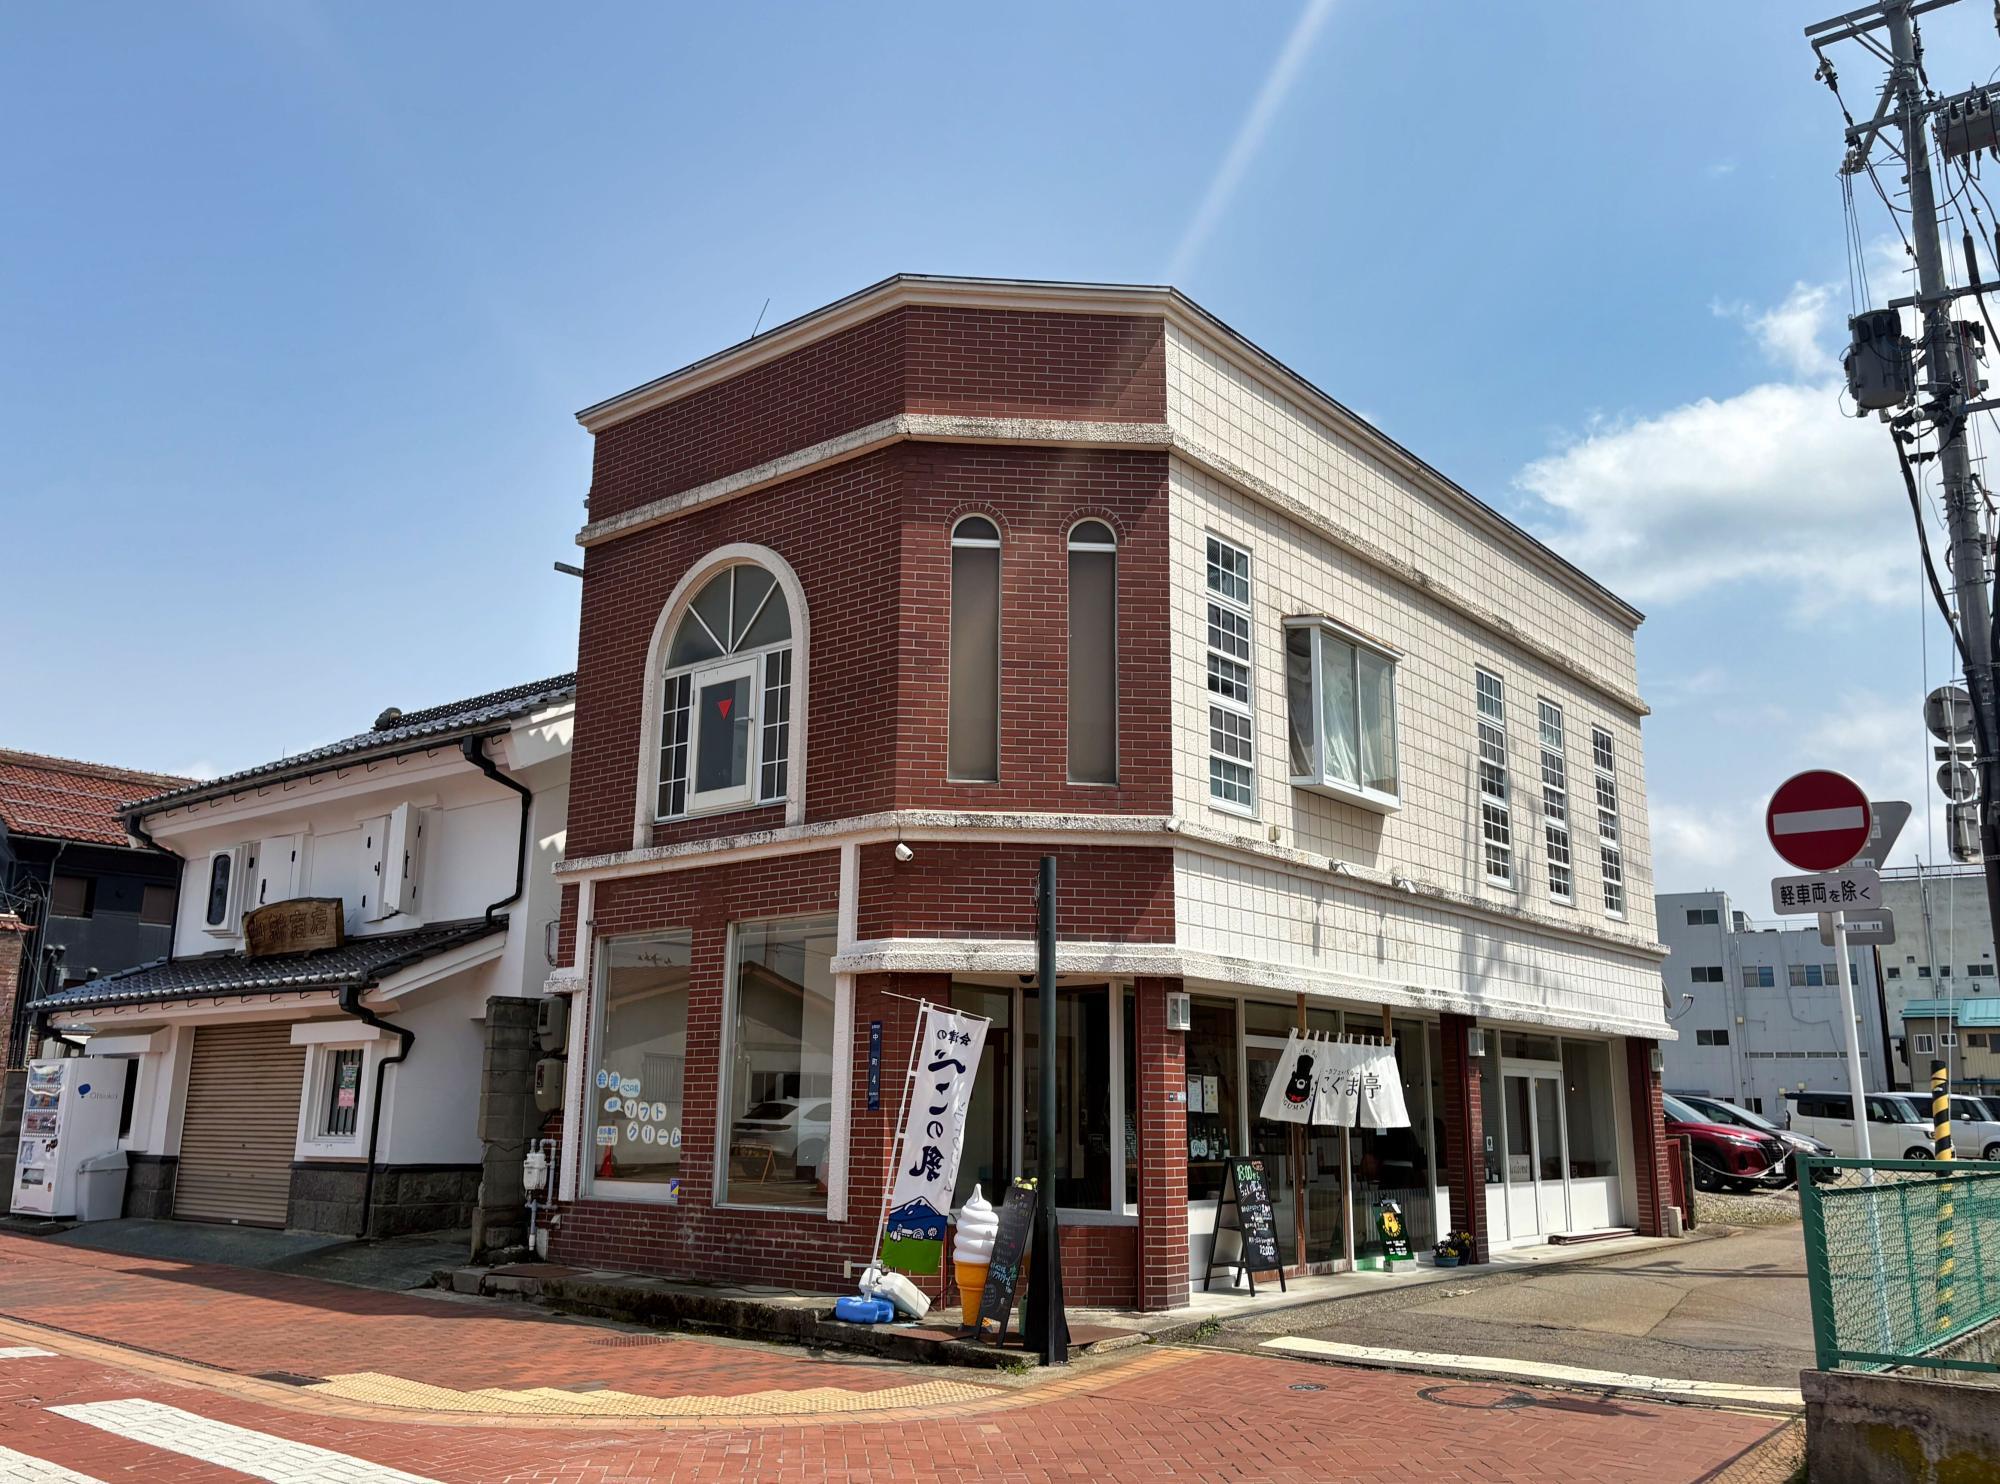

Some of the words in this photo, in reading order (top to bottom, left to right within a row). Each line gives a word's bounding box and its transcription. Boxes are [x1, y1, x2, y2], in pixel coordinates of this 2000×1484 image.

[1779, 880, 1871, 907] 軽車両を除く
[1321, 1072, 1382, 1100] こぐま亭
[626, 1102, 664, 1120] ソフト
[628, 1126, 681, 1145] クリーム
